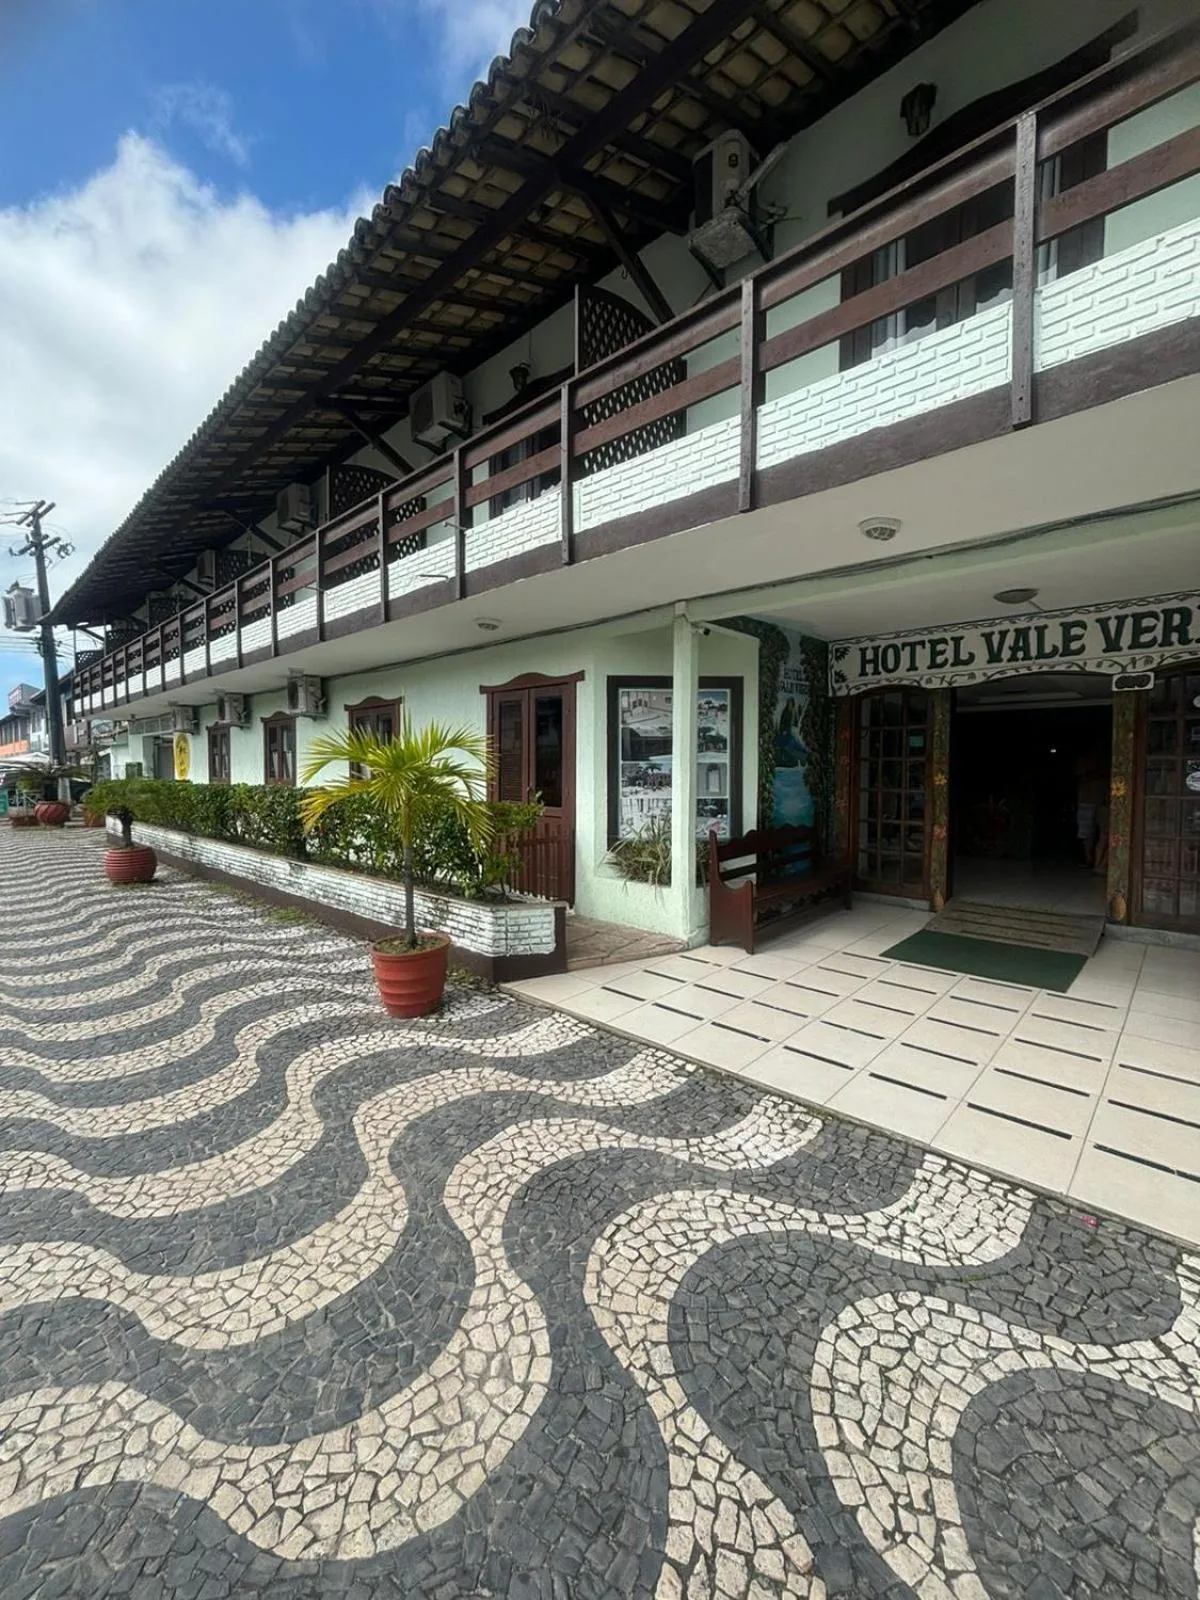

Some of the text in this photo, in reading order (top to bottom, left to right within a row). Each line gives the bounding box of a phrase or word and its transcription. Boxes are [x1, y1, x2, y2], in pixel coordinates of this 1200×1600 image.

[858, 604, 1200, 677] HOTEL VALE VER
